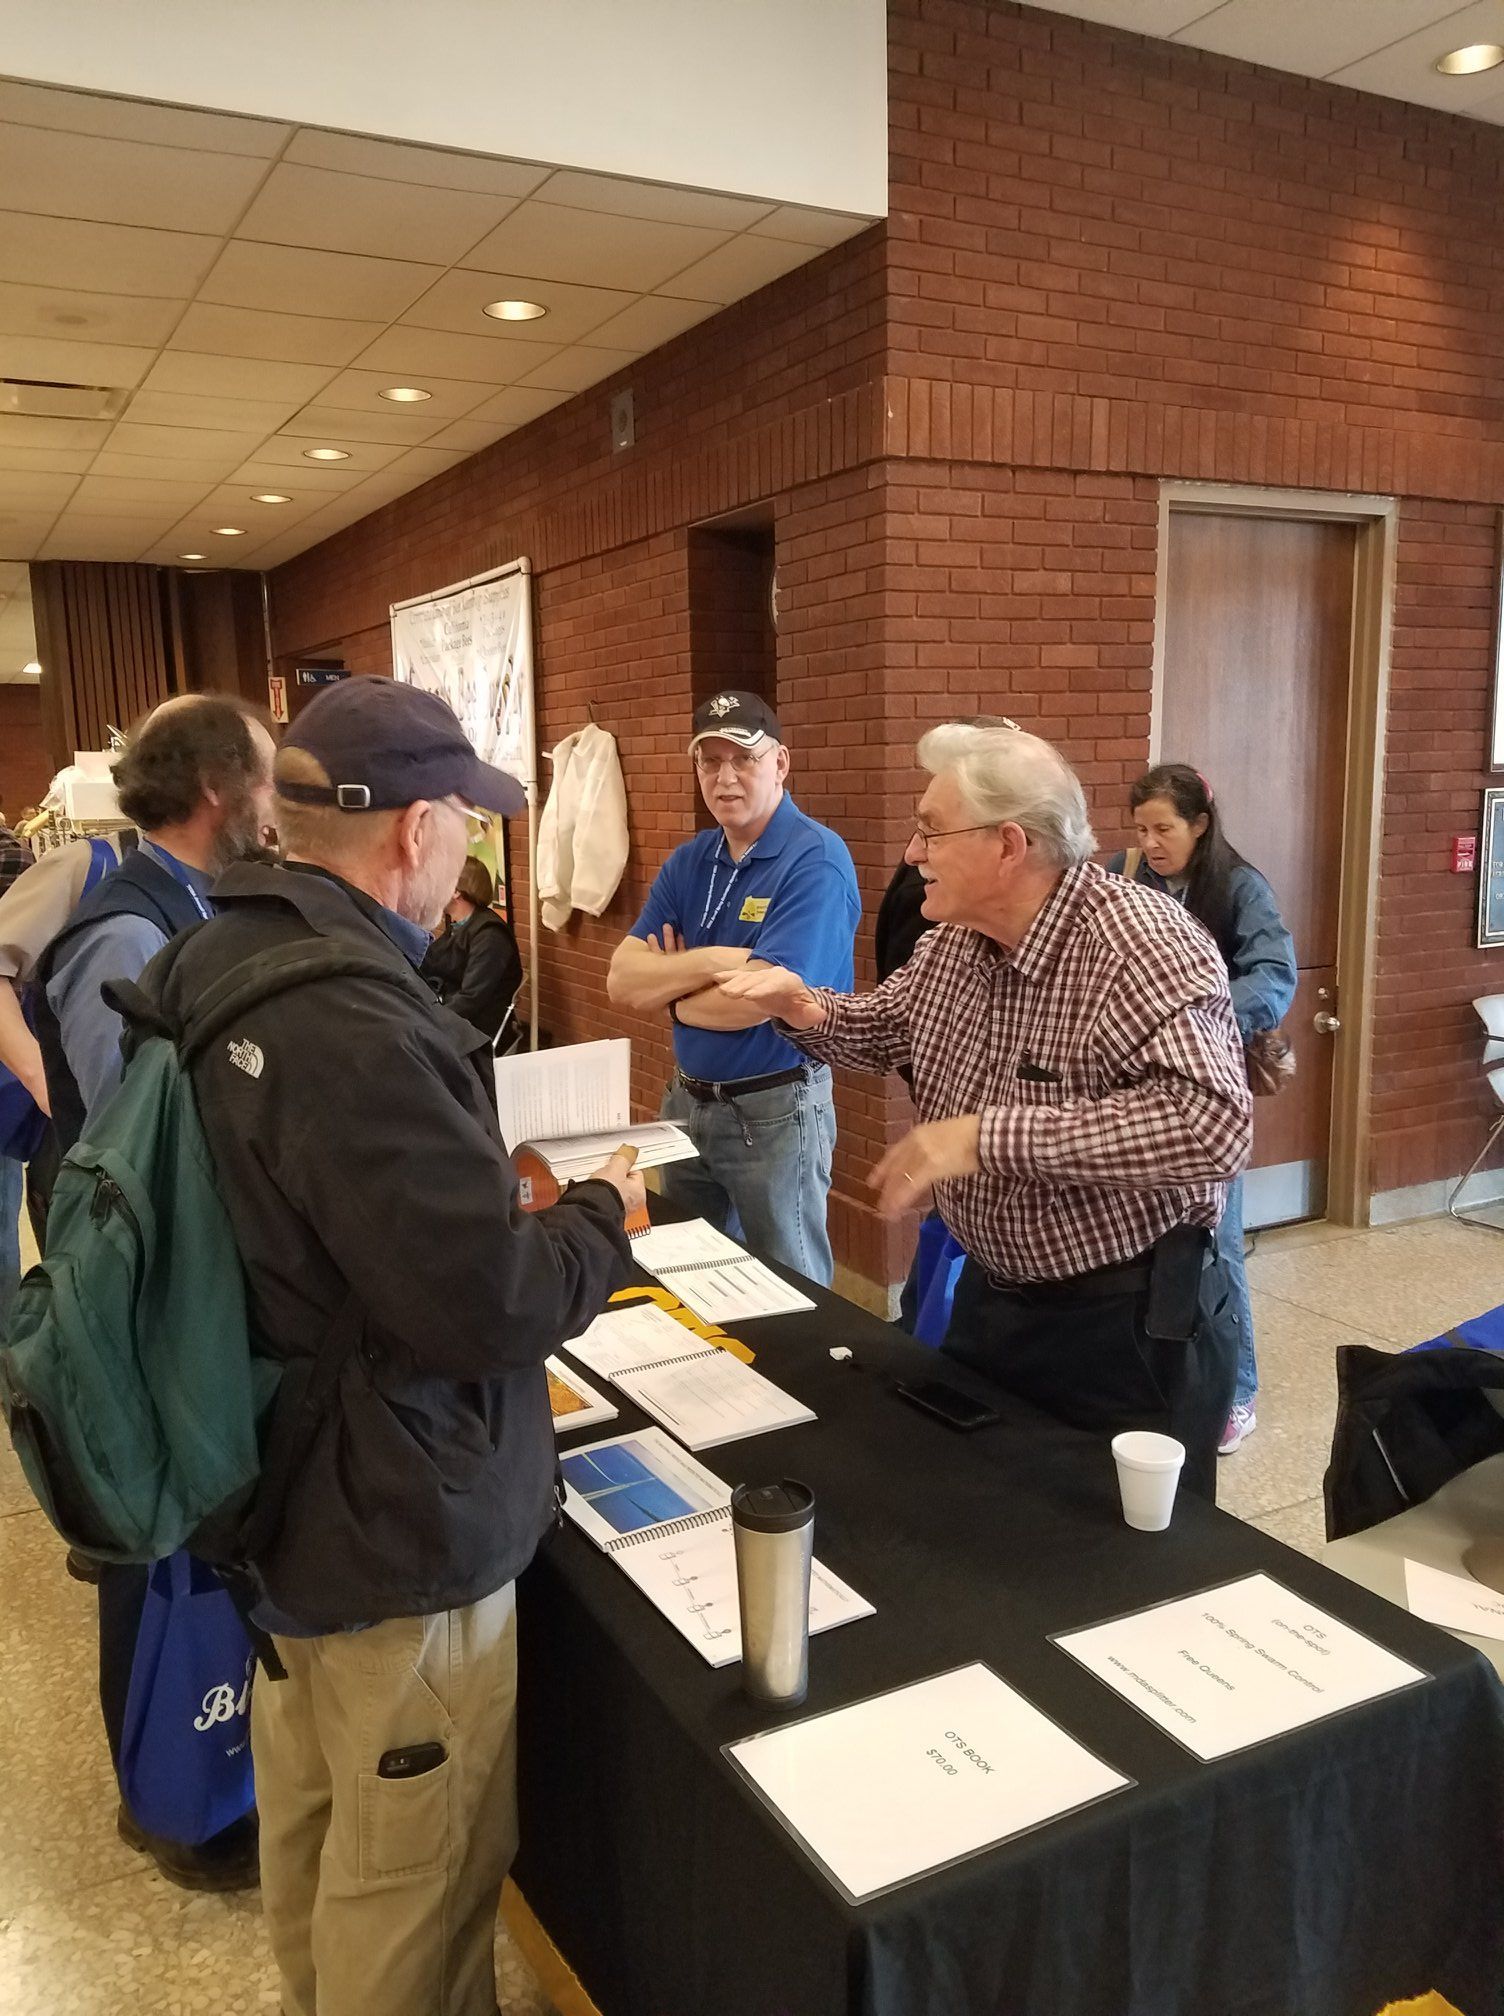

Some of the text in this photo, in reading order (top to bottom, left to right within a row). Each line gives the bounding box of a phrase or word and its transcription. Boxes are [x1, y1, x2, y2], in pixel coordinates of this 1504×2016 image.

[227, 1041, 252, 1062] NORTH
[242, 1038, 256, 1053] THE
[229, 1052, 249, 1070] FACE
[1303, 1624, 1327, 1640] OTS
[1202, 1612, 1326, 1693] 100% Spring Swarm Control
[1177, 1649, 1236, 1691] Free Queens
[926, 1748, 958, 1776] $70.00
[944, 1731, 996, 1775] OTS BOOK
